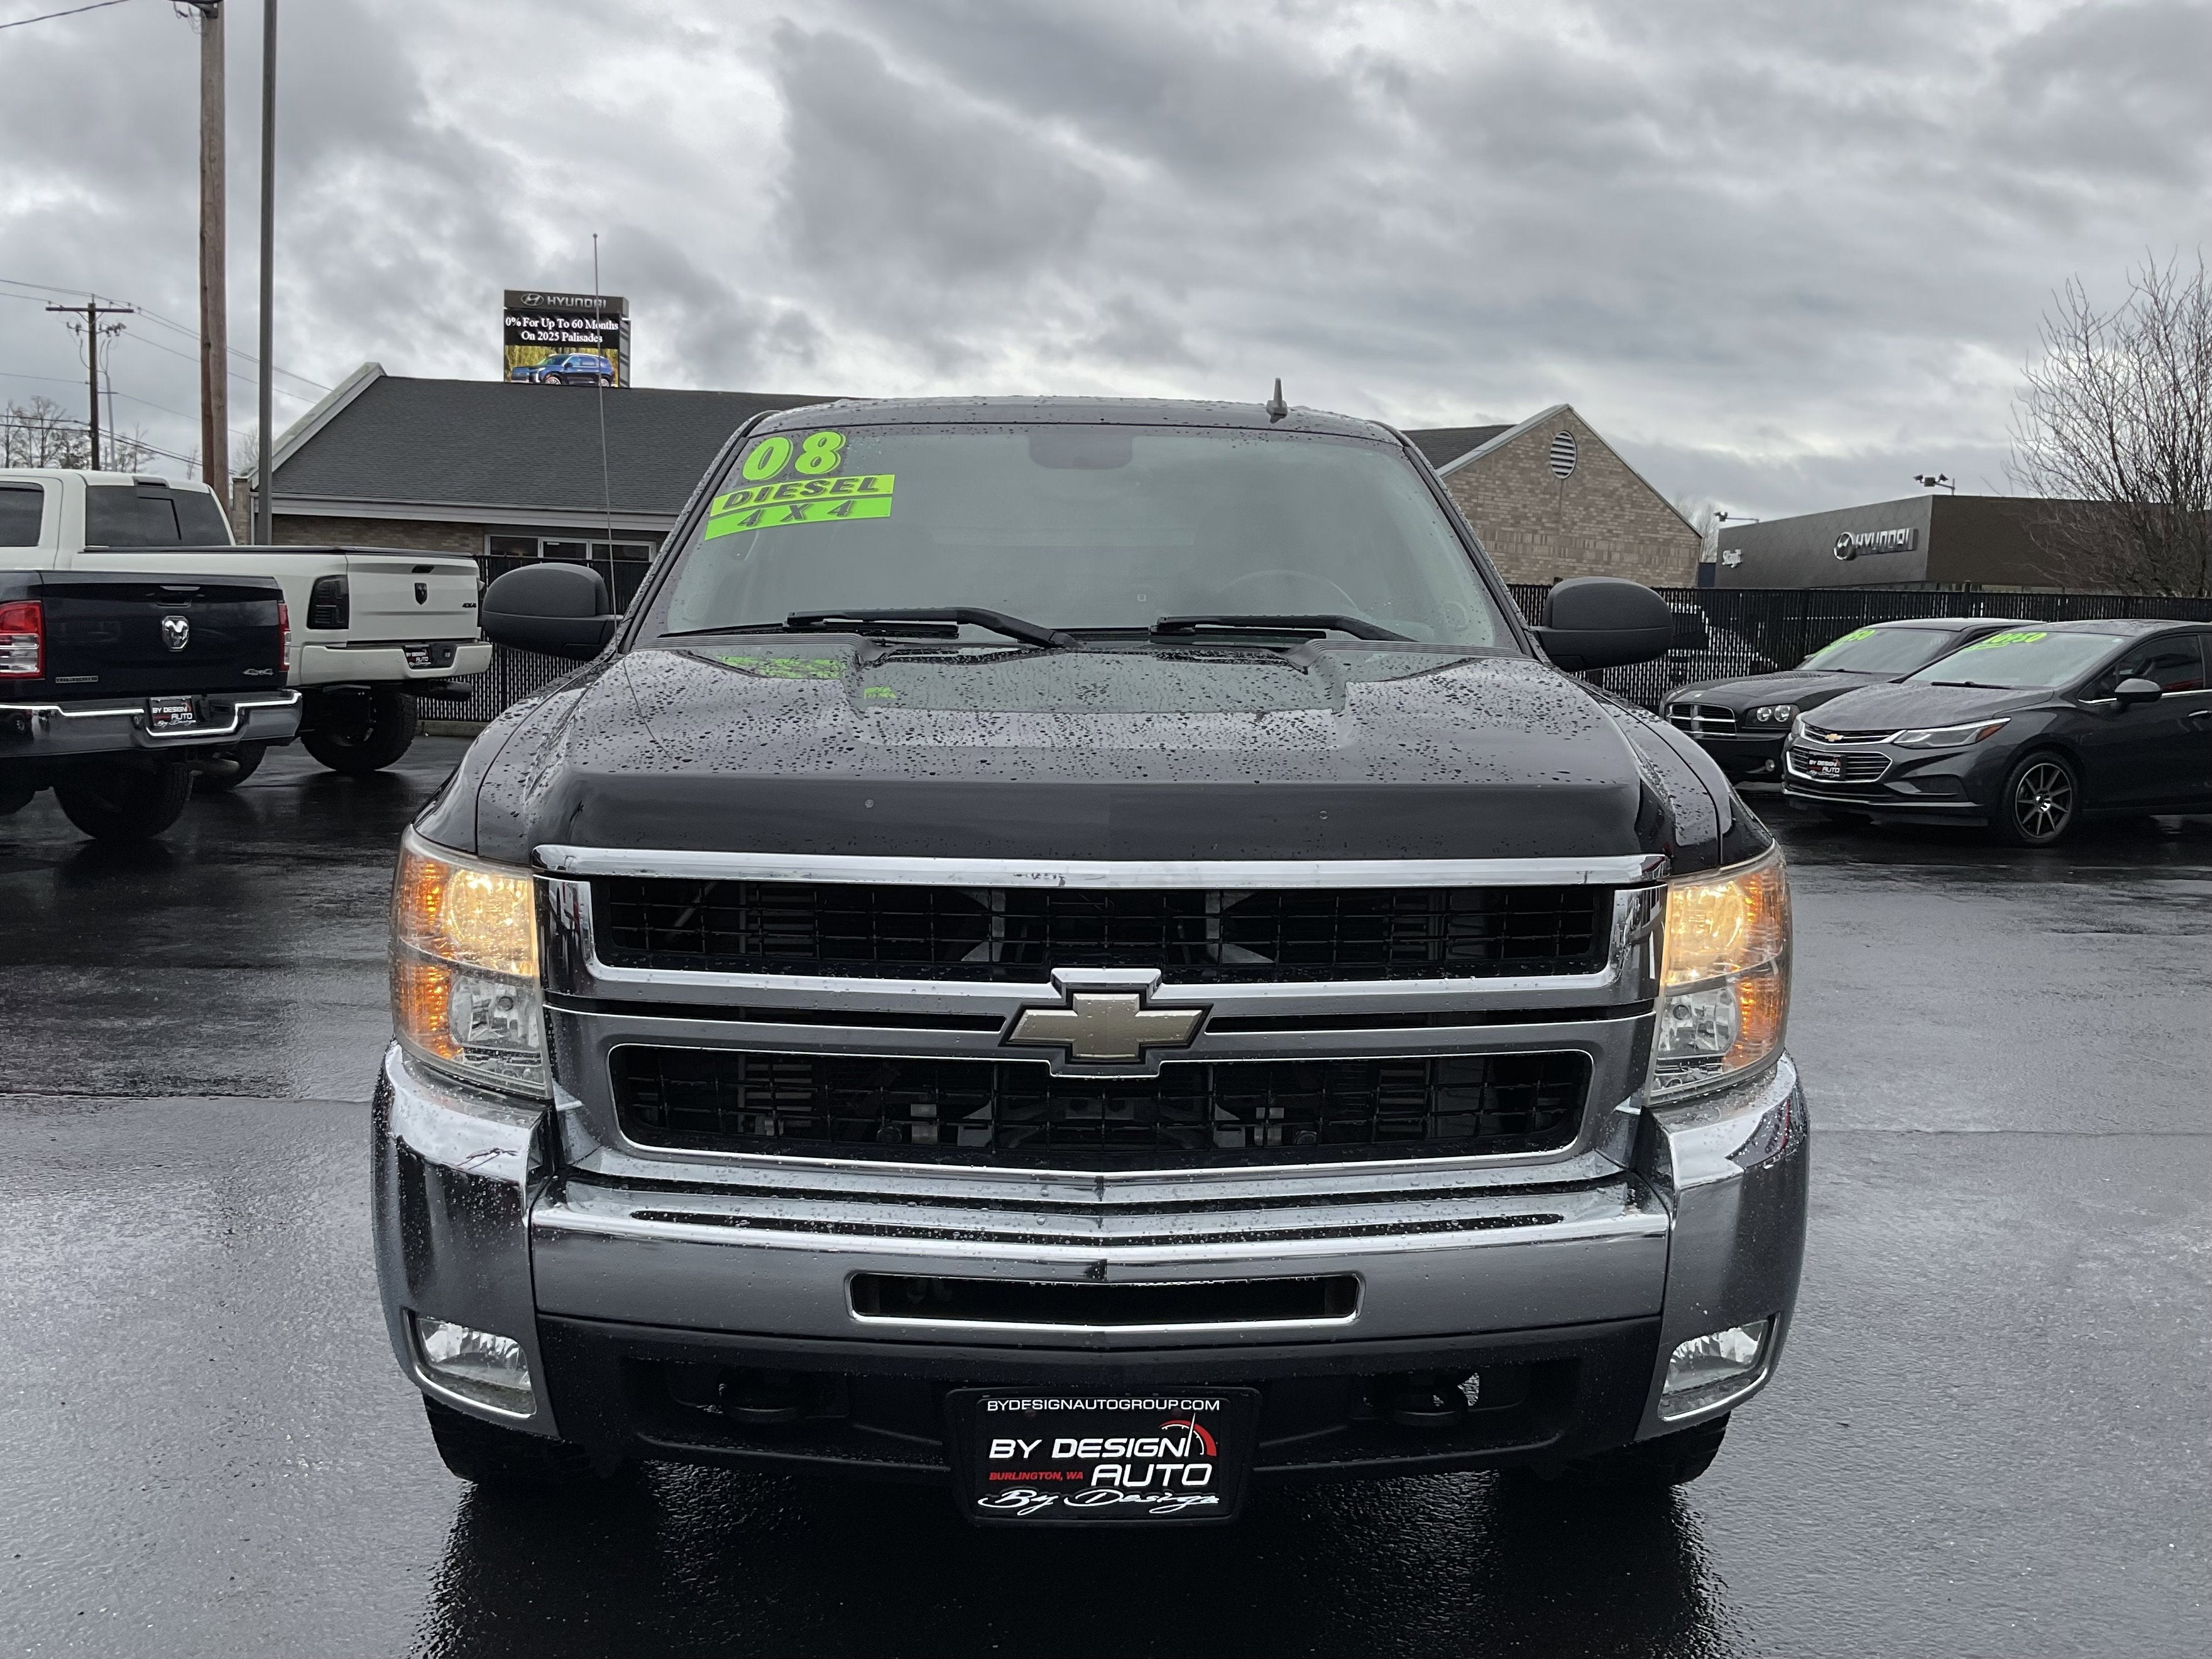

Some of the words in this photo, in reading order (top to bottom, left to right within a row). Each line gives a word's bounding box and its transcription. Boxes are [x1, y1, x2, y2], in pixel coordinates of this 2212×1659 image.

[547, 296, 607, 309] HYUNDAI
[506, 317, 521, 327] 0%
[523, 317, 539, 327] For
[541, 318, 555, 329] Up
[557, 319, 569, 329] To
[571, 319, 583, 329] 60
[585, 319, 619, 331] Months
[521, 331, 535, 341] On
[537, 332, 559, 341] 2025
[562, 332, 603, 342] Palisades
[743, 431, 846, 480] 08
[723, 476, 877, 510] DIESEL
[987, 1399, 1220, 1411] BYDESIGNAUTOGROUPCOM
[989, 1438, 1042, 1459] BY
[1051, 1437, 1190, 1458] DESIGN
[989, 1471, 1063, 1482] BURLINGTON,
[1066, 1471, 1084, 1481] WA
[1091, 1463, 1213, 1487] AUTO
[978, 1489, 1059, 1516] By
